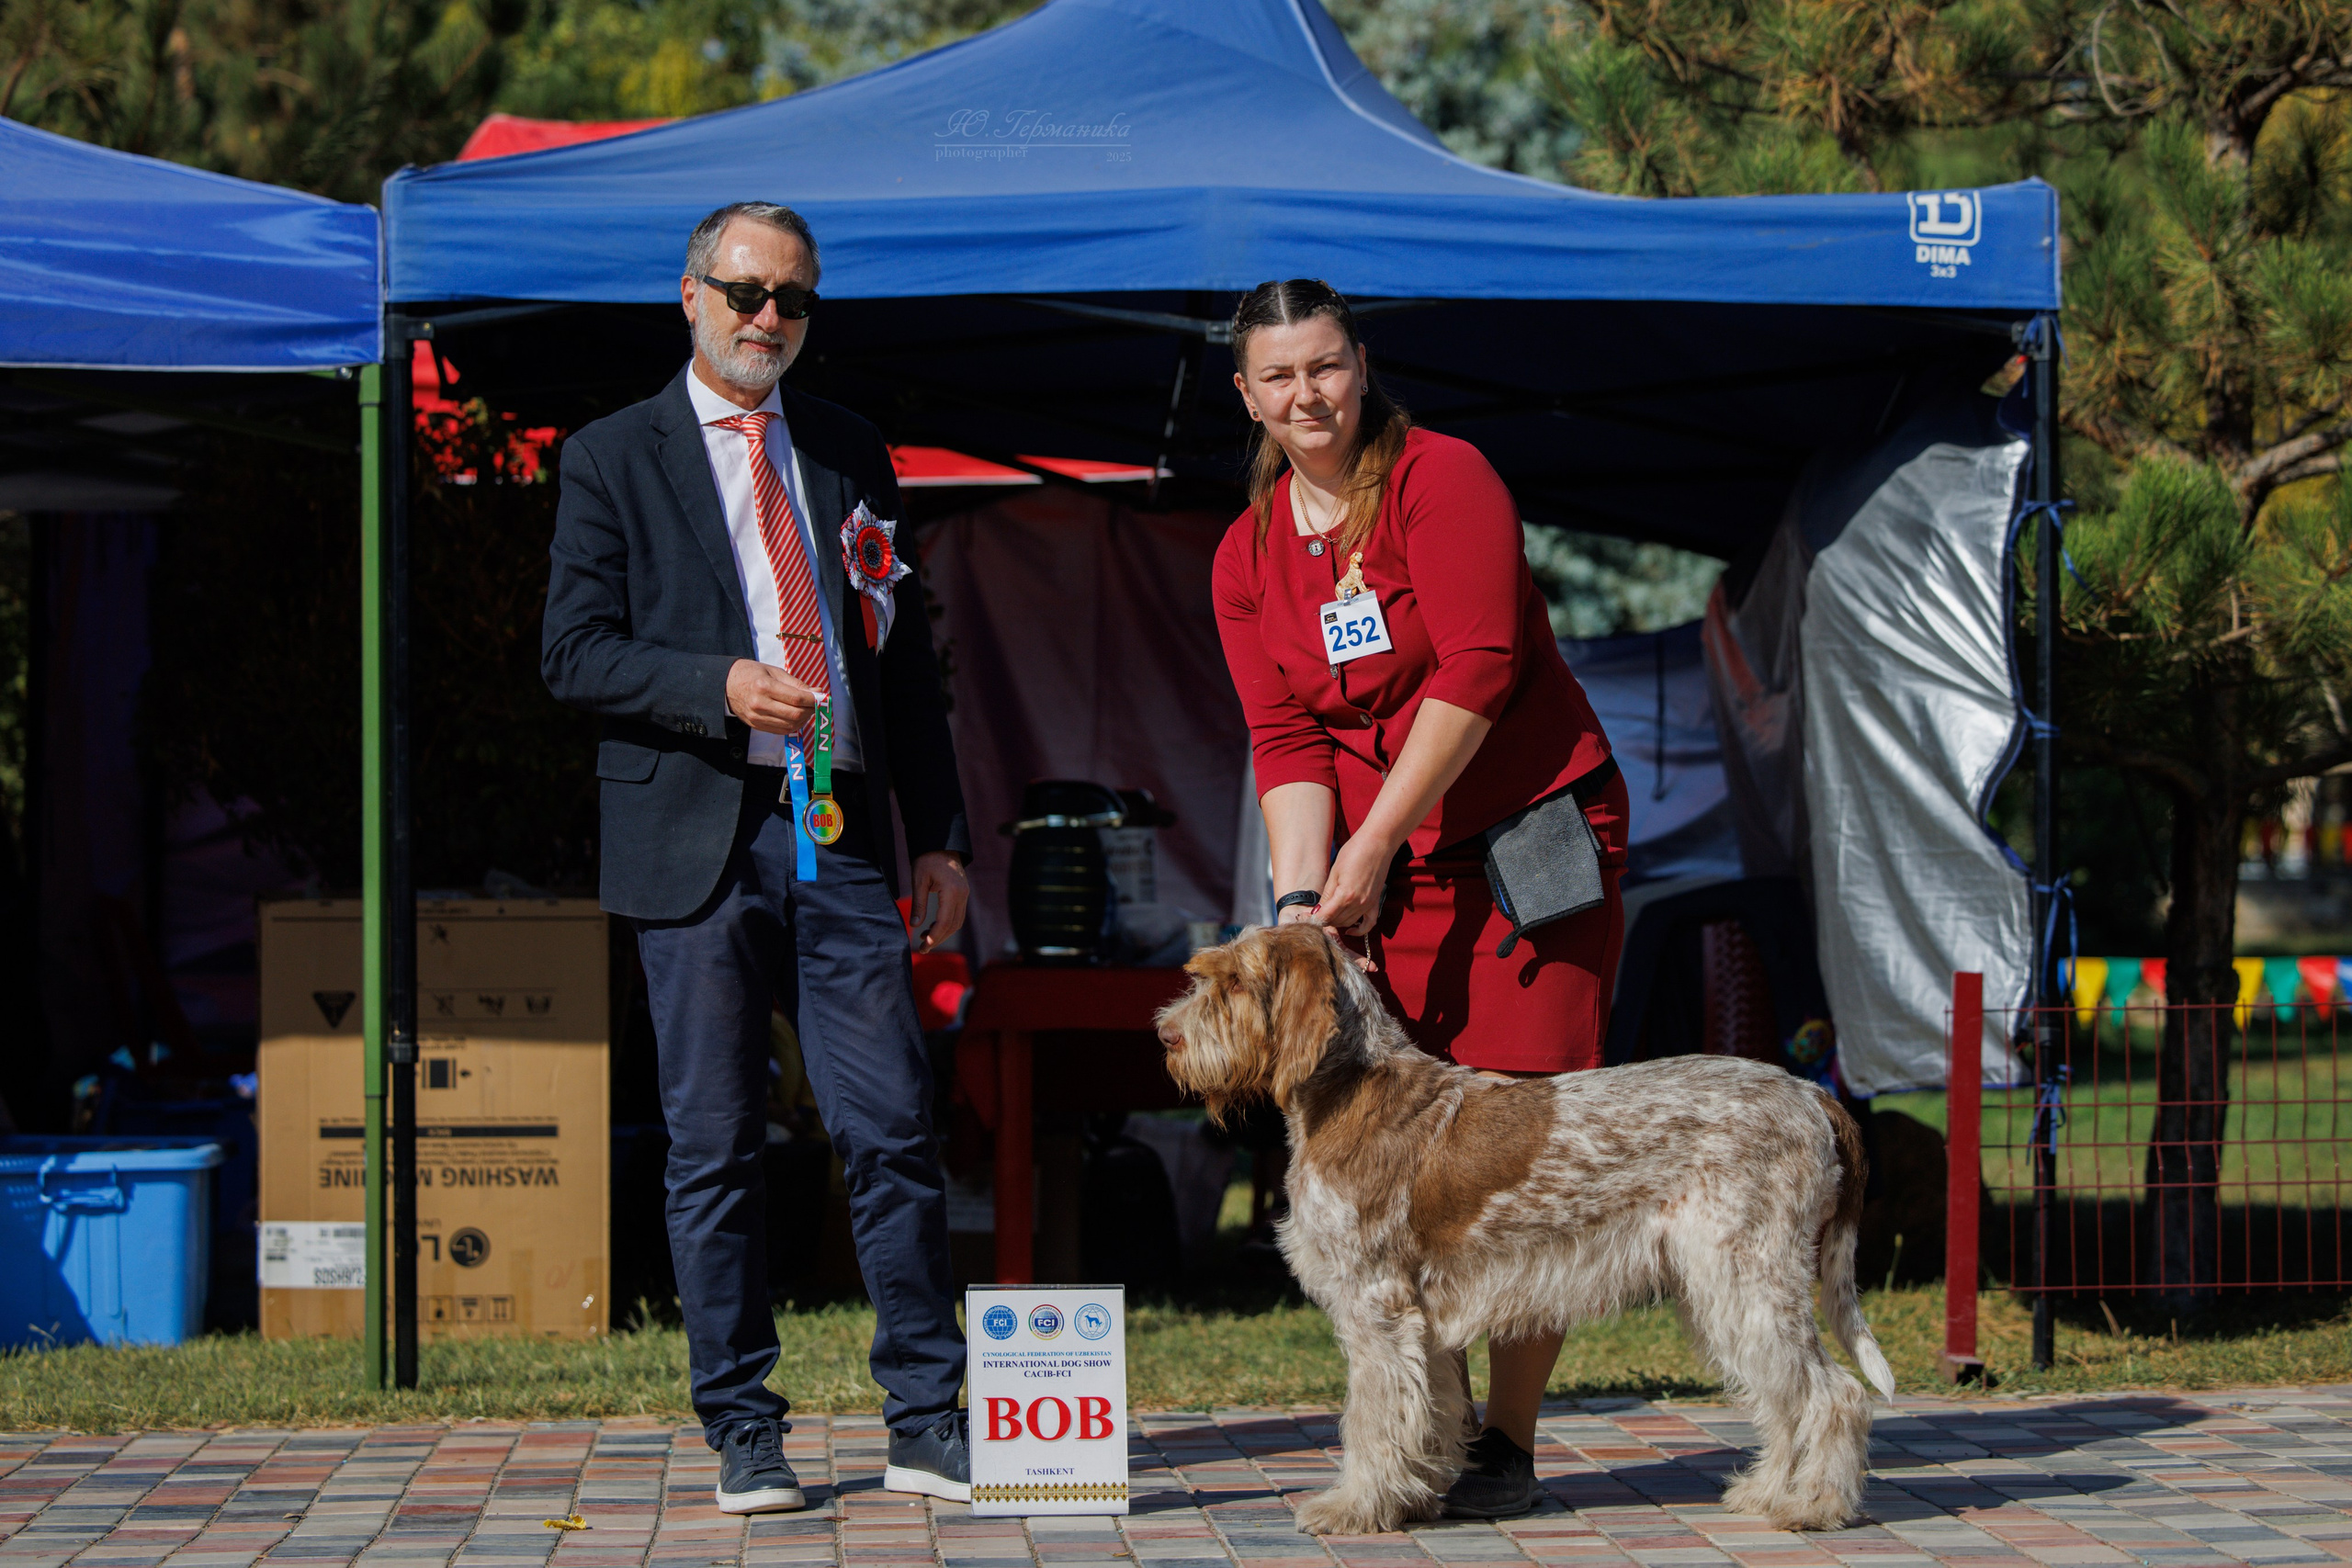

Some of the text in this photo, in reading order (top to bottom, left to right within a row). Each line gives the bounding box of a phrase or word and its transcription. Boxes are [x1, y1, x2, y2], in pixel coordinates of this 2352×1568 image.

[1916, 244, 1972, 266] DIMA
[1329, 616, 1381, 652] 252
[813, 814, 833, 828] BOB
[441, 1168, 559, 1188] WASHING
[993, 1318, 1007, 1326] FCI
[1037, 1318, 1055, 1326] FCI
[1023, 1370, 1072, 1378] CACIB-FCI
[982, 1395, 1114, 1441] BOB
[1025, 1467, 1075, 1476] TASHKENT
